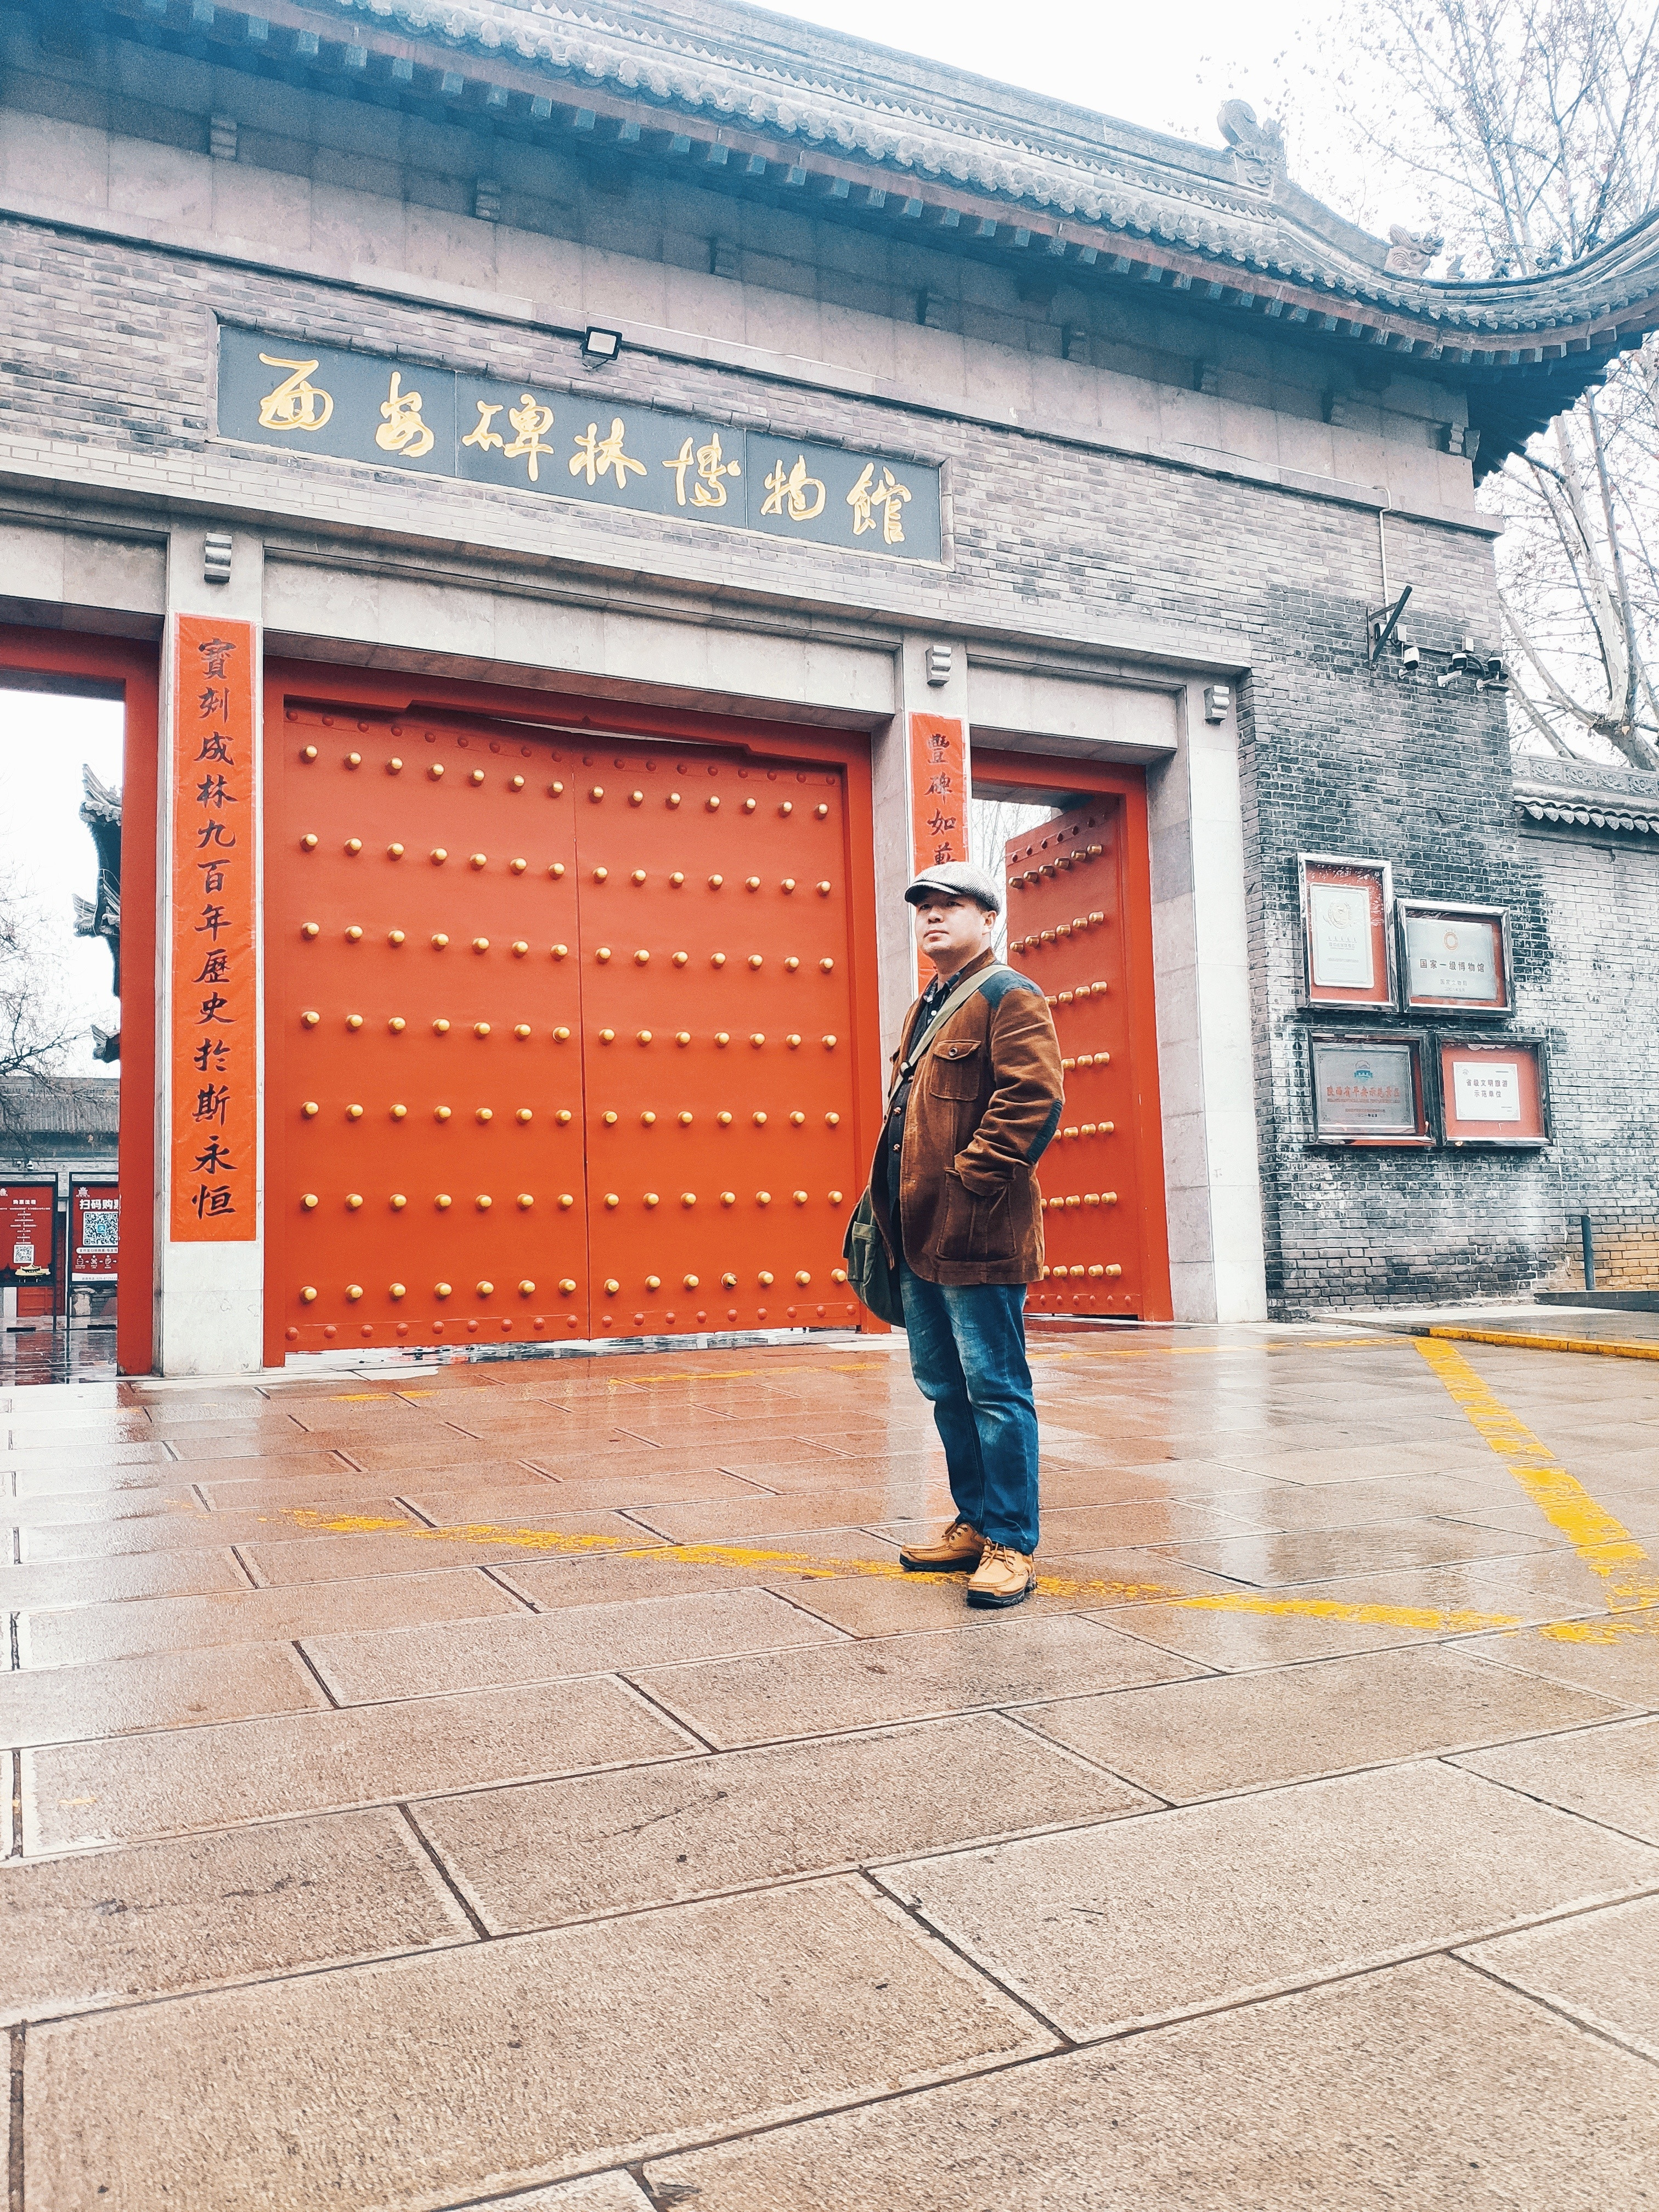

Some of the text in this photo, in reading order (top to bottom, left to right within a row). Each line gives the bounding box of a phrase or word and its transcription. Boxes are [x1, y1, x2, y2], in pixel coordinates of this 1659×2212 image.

[1419, 958, 1485, 973] 国家一级博物馆
[1466, 1079, 1508, 1088] 省级文明旅游
[1474, 1090, 1502, 1098] 示范单位
